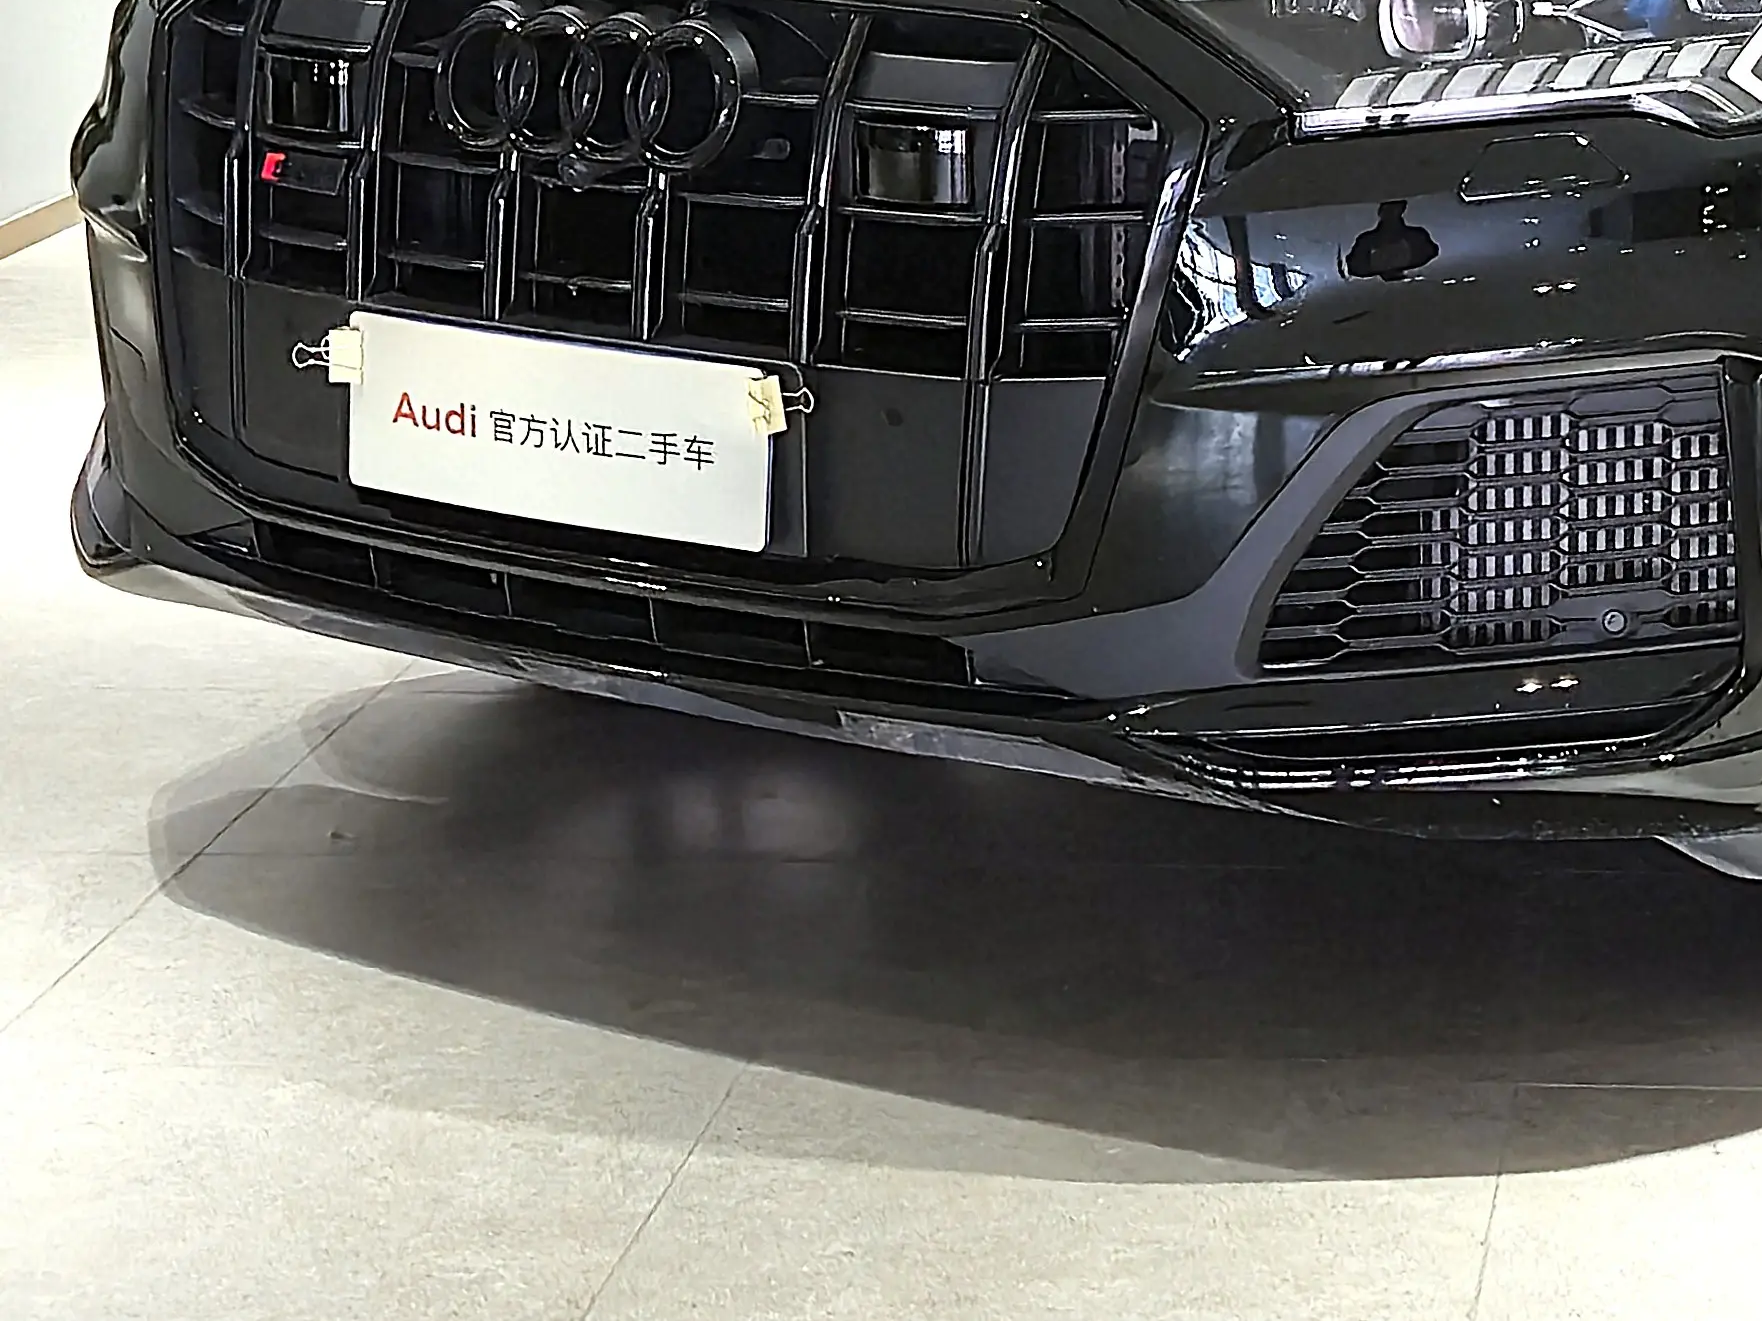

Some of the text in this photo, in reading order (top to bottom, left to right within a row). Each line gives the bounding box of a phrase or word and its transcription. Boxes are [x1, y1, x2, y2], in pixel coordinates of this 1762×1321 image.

[391, 391, 716, 471] Audi 官方认证二手车
